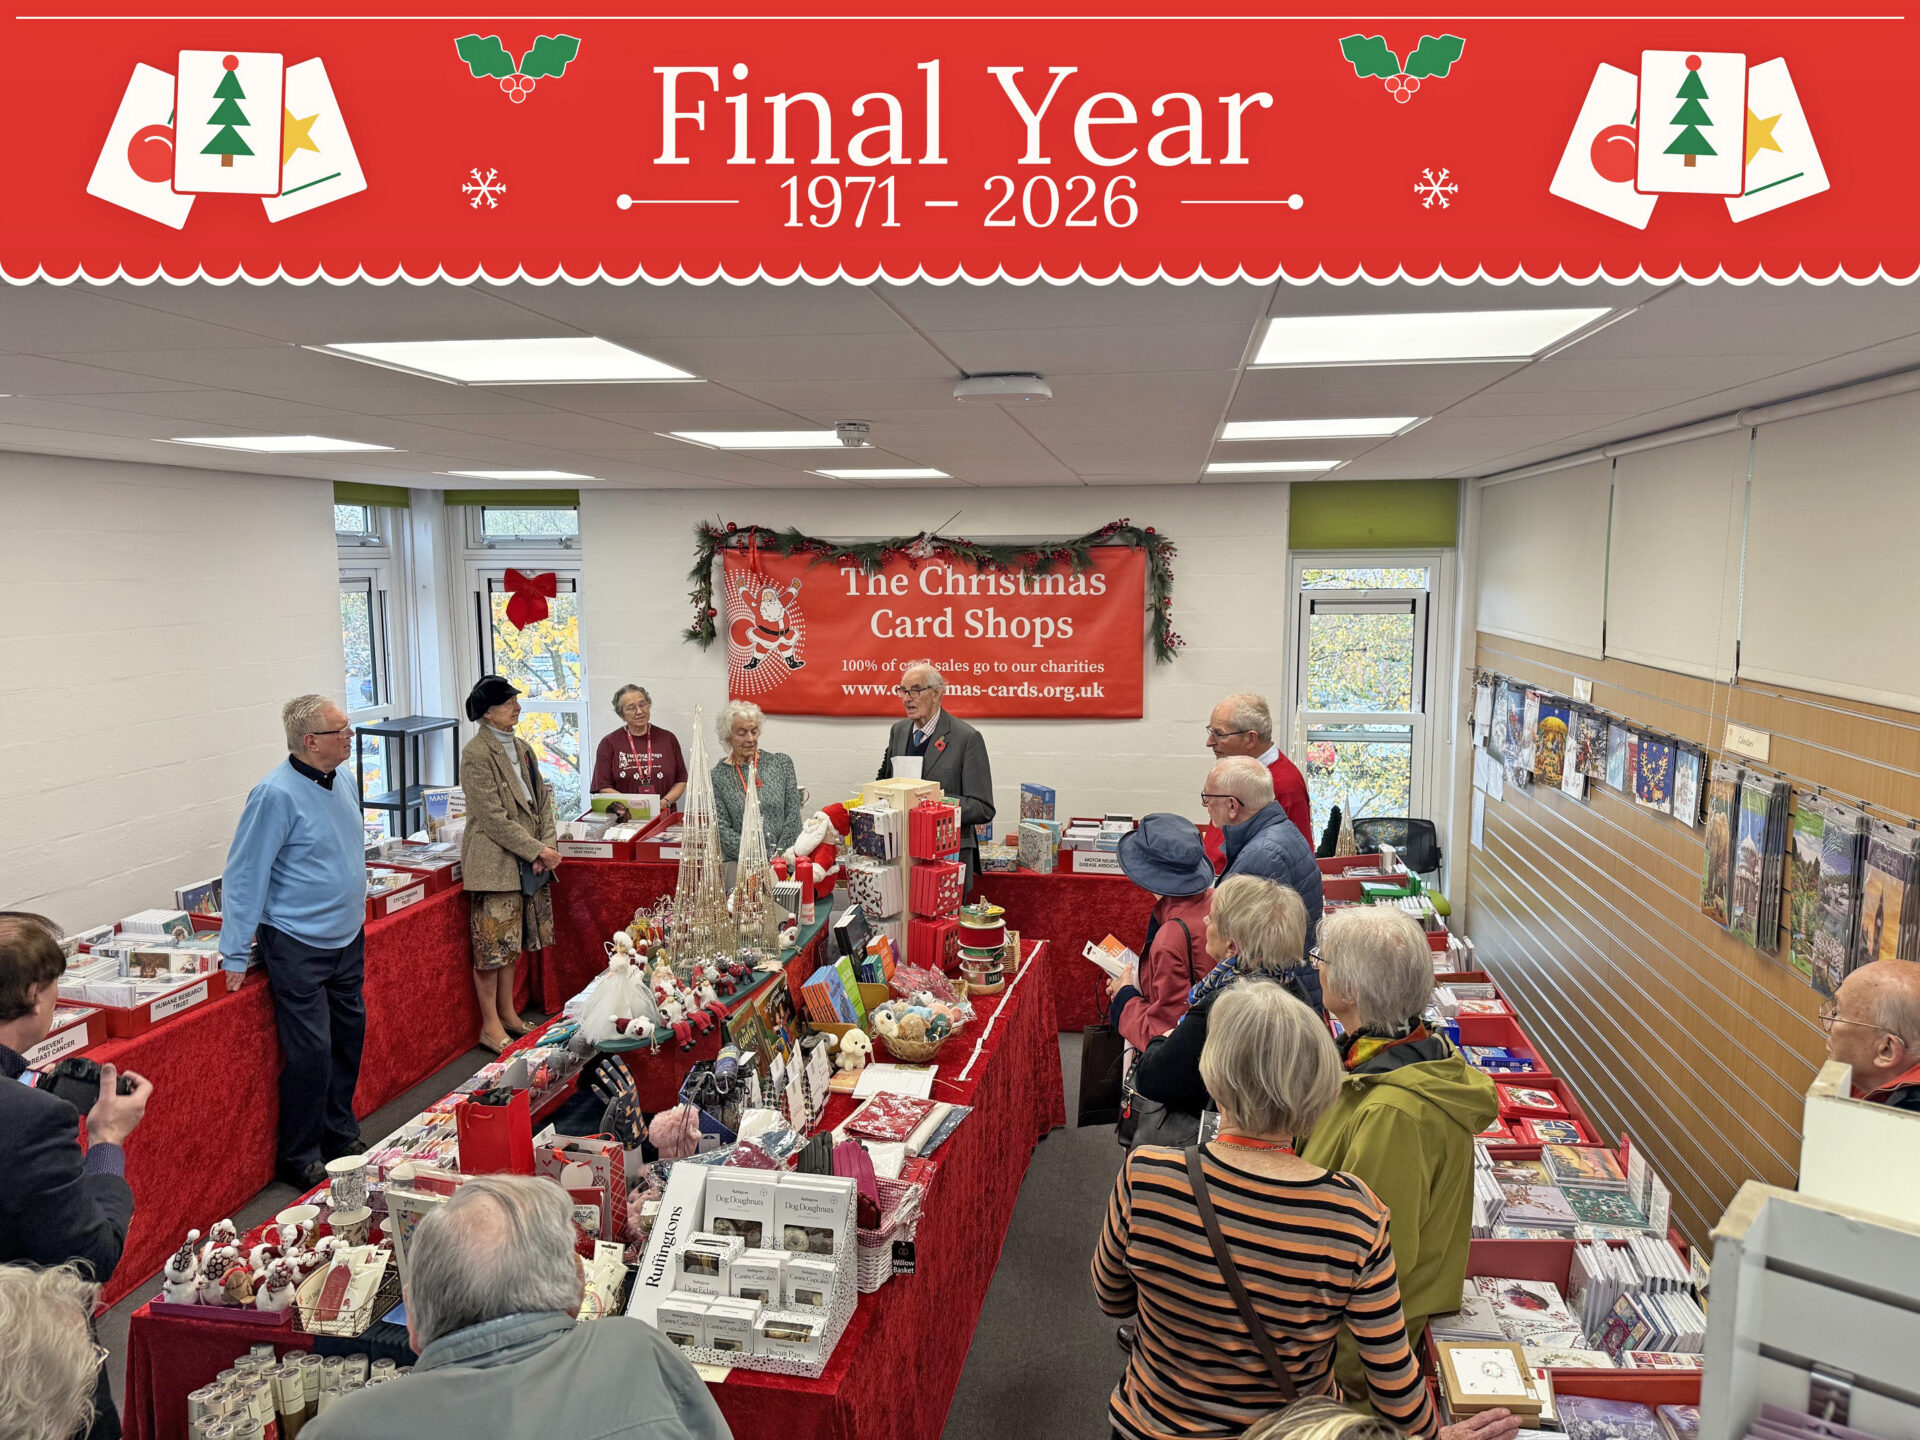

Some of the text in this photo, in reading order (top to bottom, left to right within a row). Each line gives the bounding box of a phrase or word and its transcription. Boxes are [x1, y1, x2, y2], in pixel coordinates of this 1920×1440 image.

[840, 565, 1107, 596] The Christmas
[870, 607, 1073, 647] Card Shops
[841, 659, 878, 672] 100%
[882, 658, 898, 672] of
[935, 659, 969, 672] sales
[973, 662, 990, 675] go
[993, 660, 1008, 673] to
[1011, 662, 1038, 673] our
[1040, 659, 1105, 673] charities
[841, 681, 1105, 701] www.cmas-cards.org.uk
[155, 986, 203, 1010] HUMANE RESEARCH
[172, 999, 189, 1010] TRUST
[38, 1037, 64, 1053] PREVENT
[52, 1040, 75, 1055] CANCER
[716, 1194, 764, 1206] Dog Doughnuts
[785, 1201, 834, 1214] Dog Doughnuts
[645, 1206, 682, 1288] Ruffingtons
[684, 1285, 699, 1294] Dog
